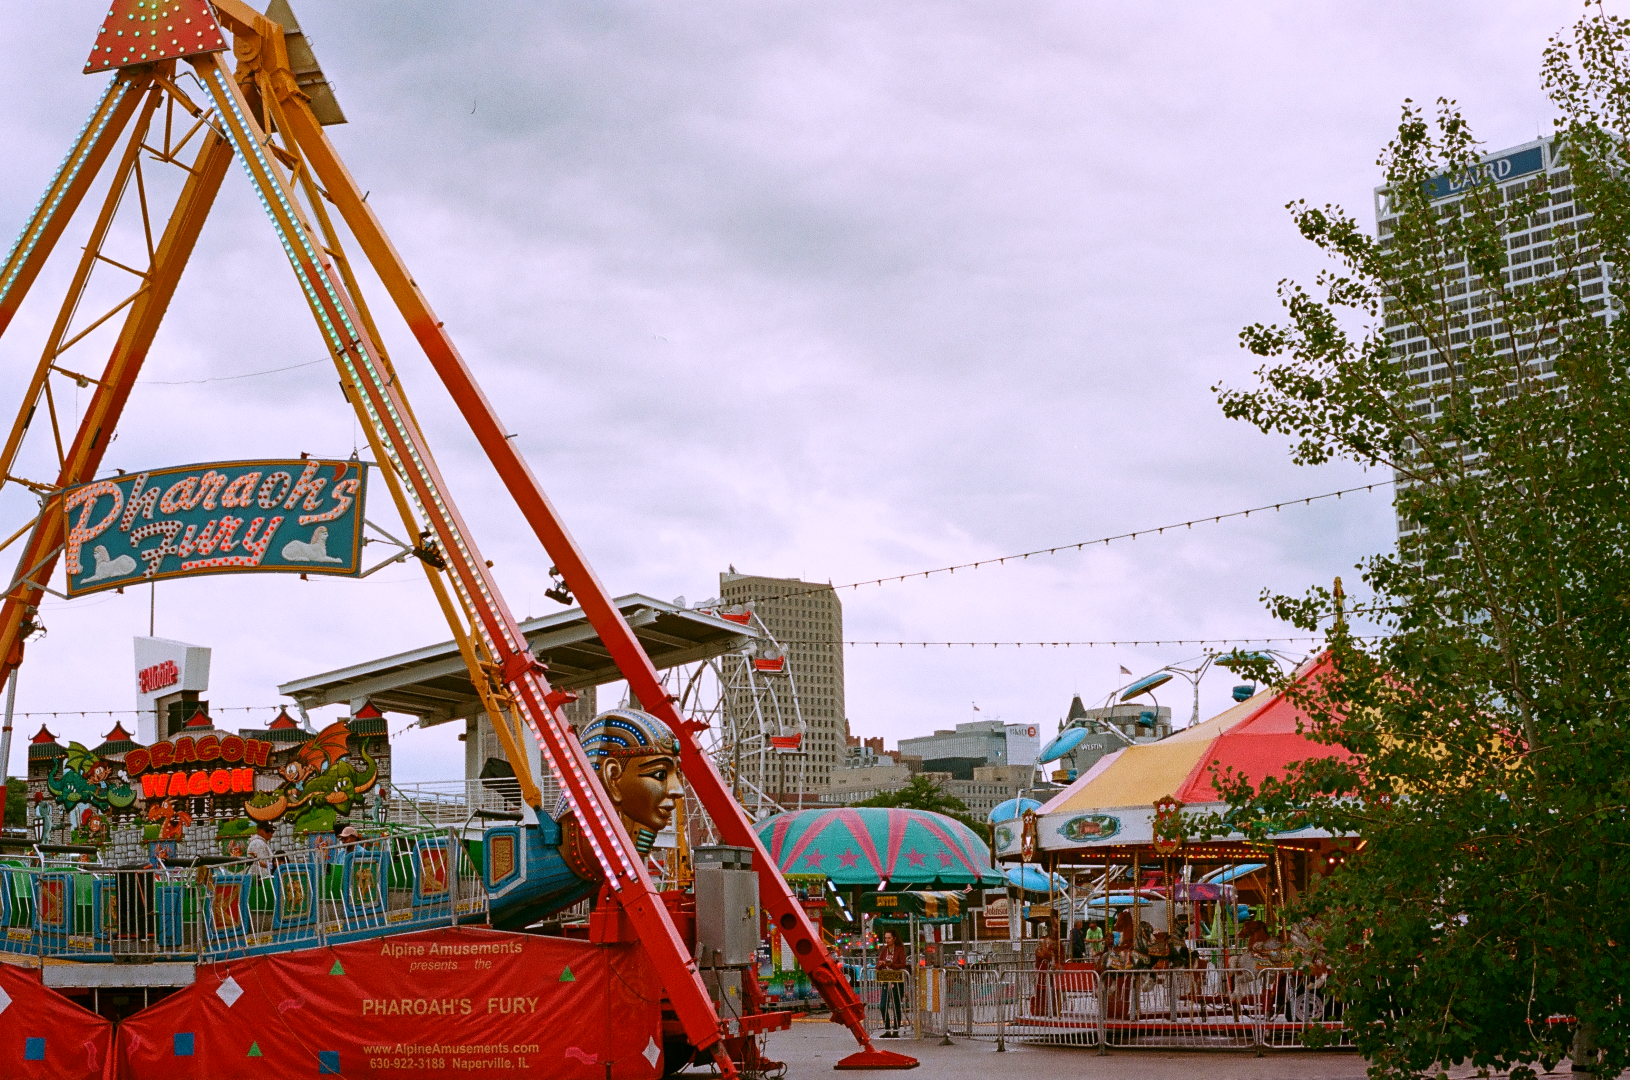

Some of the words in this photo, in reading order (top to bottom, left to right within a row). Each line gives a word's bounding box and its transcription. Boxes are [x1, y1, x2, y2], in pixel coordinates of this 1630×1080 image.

[1449, 159, 1511, 191] BAIRD
[64, 460, 361, 575] Pharaoh's
[130, 515, 284, 578] Fury
[124, 734, 273, 776] DRAGON
[1080, 743, 1103, 751] WESTIN
[141, 767, 255, 798] WAGON
[381, 943, 425, 959] Alpine
[429, 942, 523, 956] Amusements
[409, 959, 458, 972] presents
[474, 958, 492, 970] the
[362, 998, 472, 1016] PHAROAH'S
[487, 996, 539, 1014] FURY
[363, 1042, 539, 1057] www.AlpineAmusements.com
[370, 1058, 445, 1070] 630-922-3188
[452, 1057, 515, 1071] Naperville,
